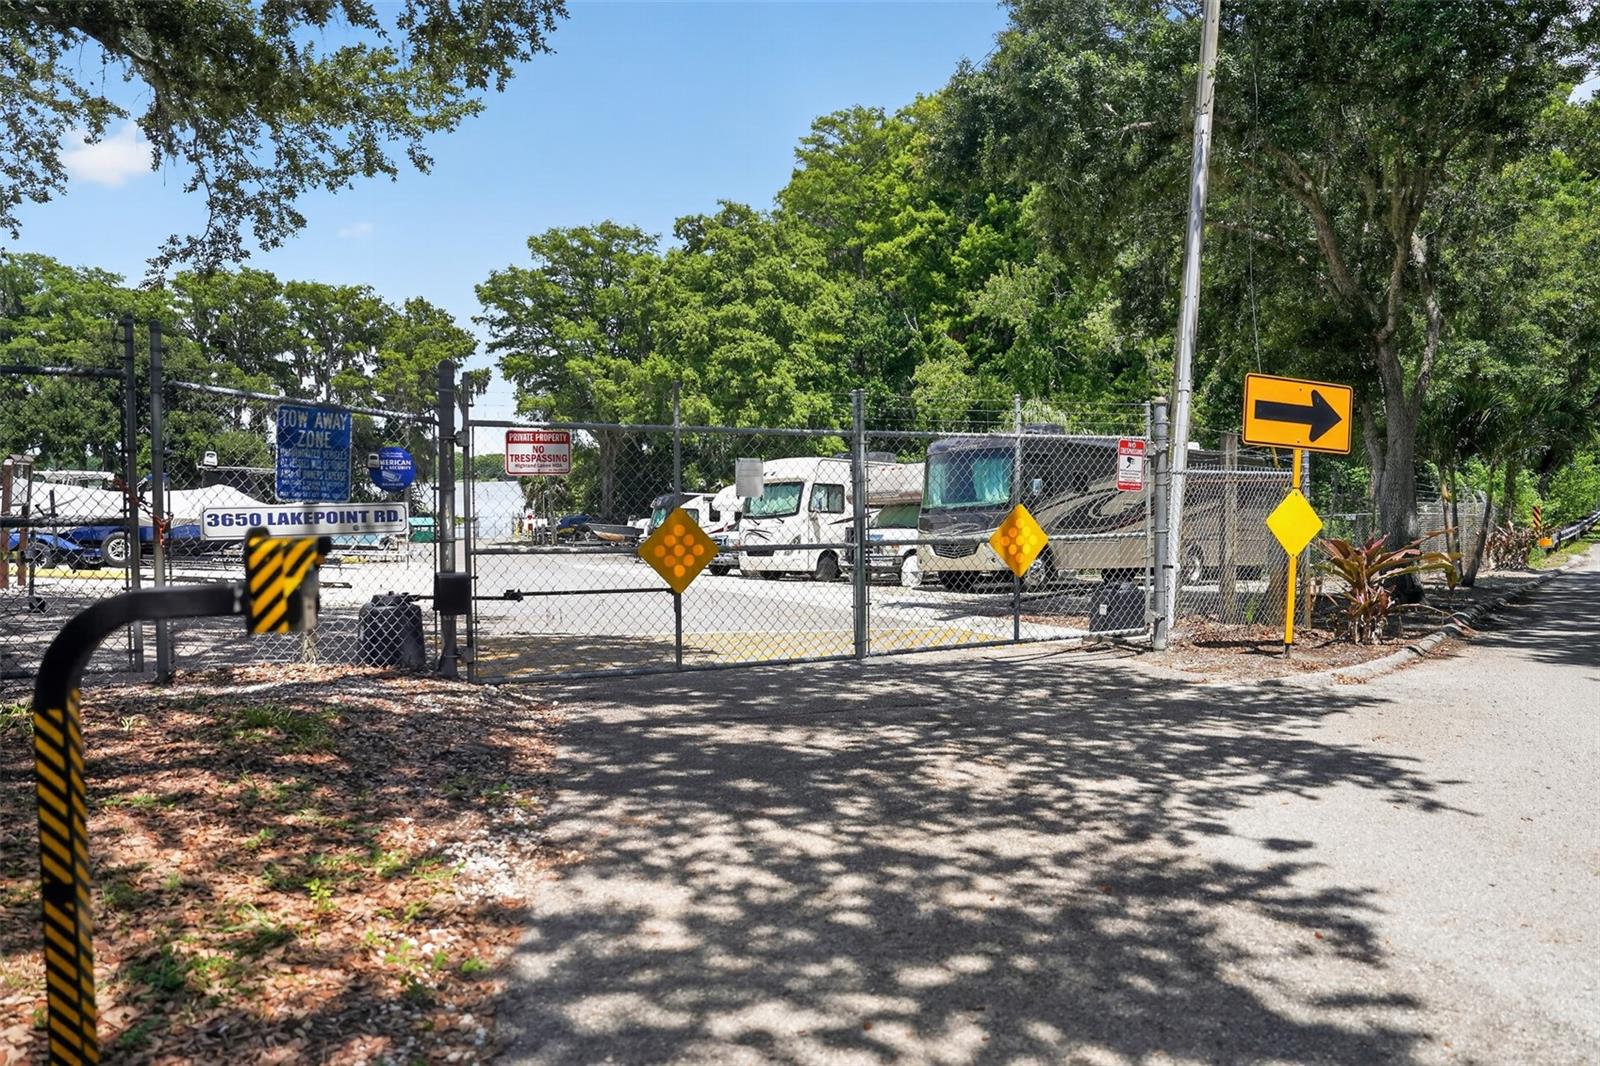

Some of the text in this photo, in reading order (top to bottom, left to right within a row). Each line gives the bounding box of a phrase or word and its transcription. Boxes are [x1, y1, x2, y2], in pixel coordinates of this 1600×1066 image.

[281, 409, 348, 431] TOW AWAY
[298, 430, 331, 449] ZONE
[509, 433, 567, 441] PRIVATE PROPERTY
[532, 445, 545, 454] NO
[510, 454, 568, 463] TRESPASSING
[206, 509, 403, 527] 3650 LAKEPOINT RD.
